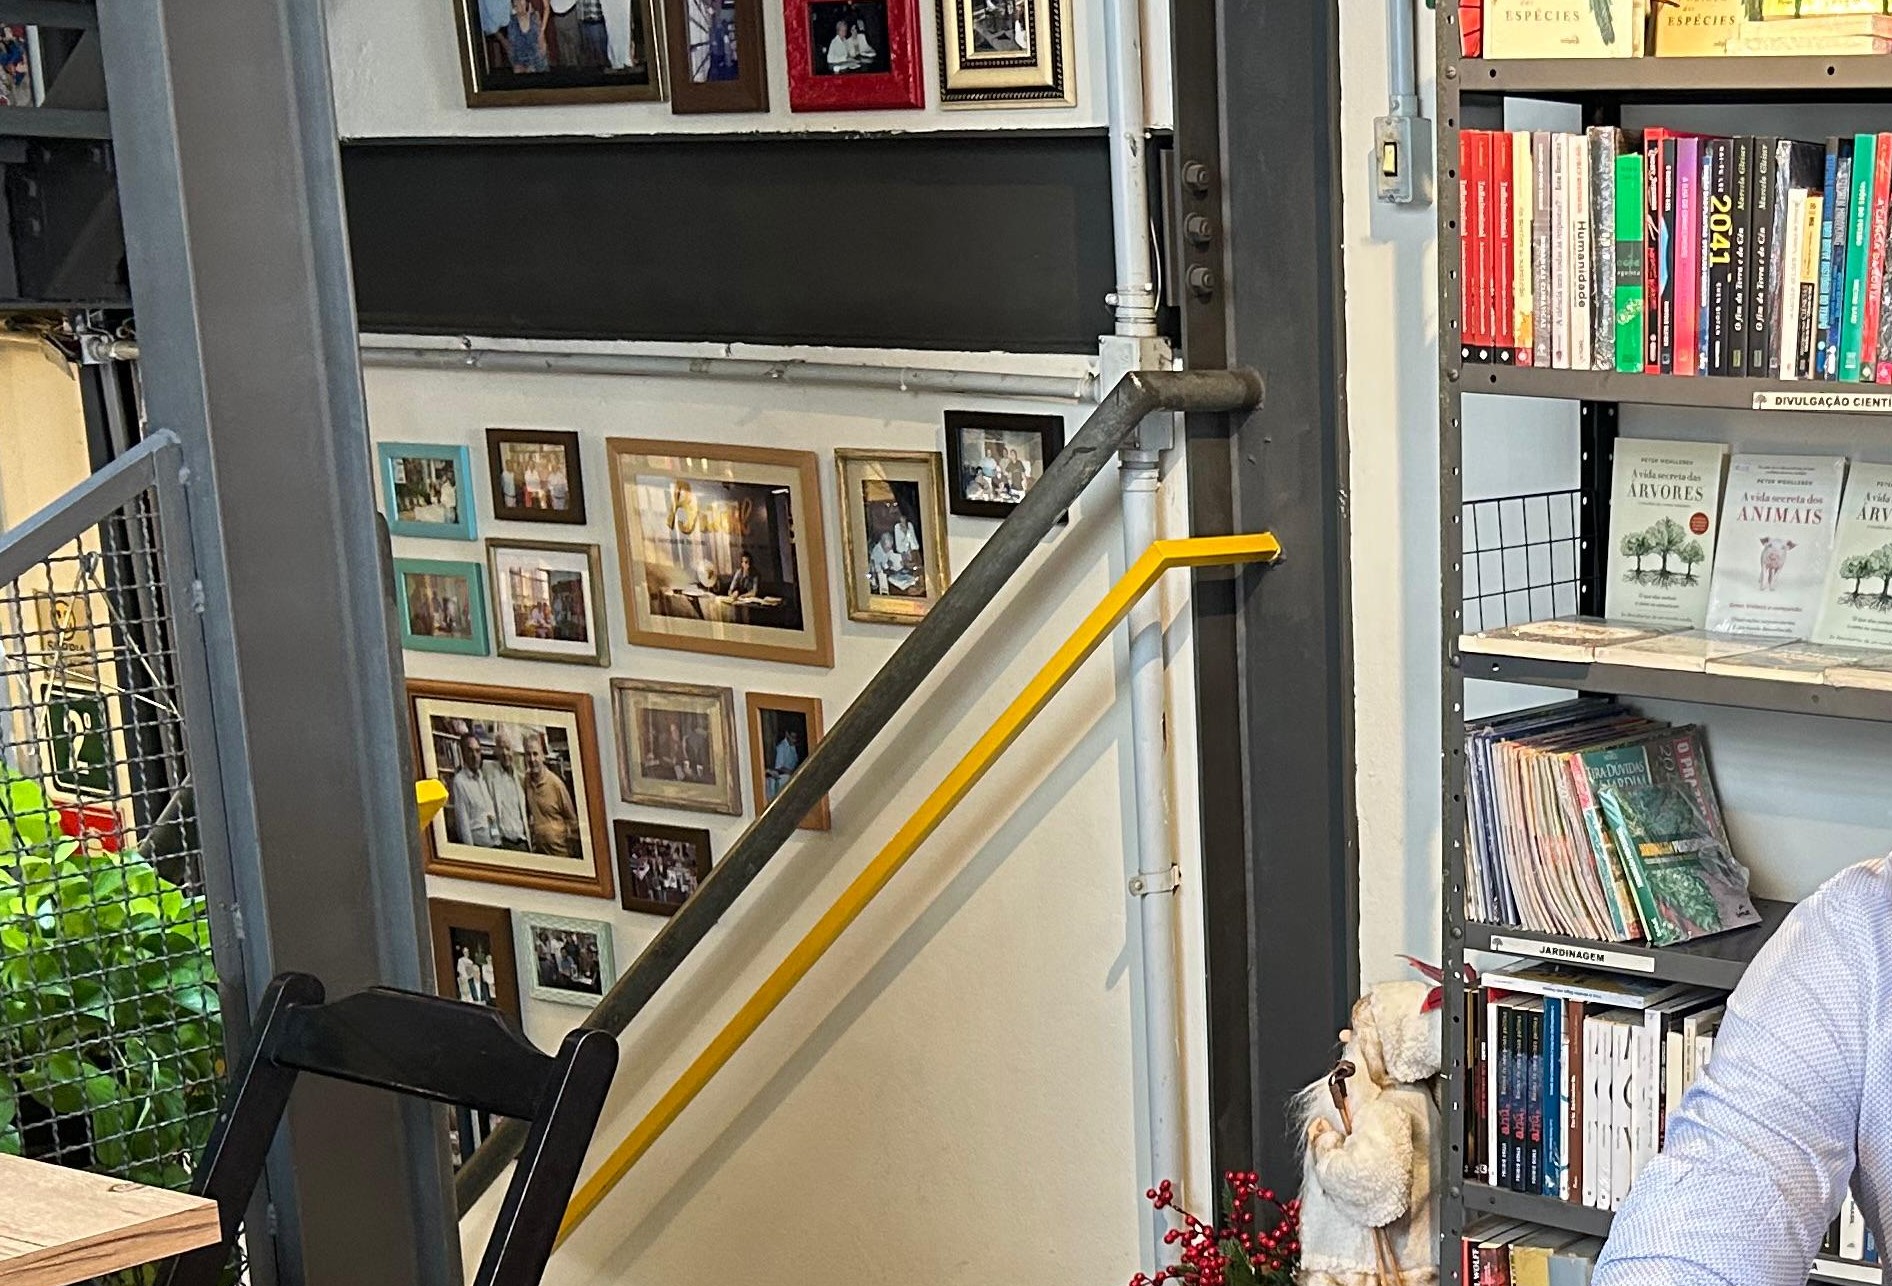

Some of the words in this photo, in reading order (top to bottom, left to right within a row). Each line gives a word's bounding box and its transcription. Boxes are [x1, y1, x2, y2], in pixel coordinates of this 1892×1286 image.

[1504, 9, 1582, 24] ESPÉCIES
[1666, 13, 1737, 28] ESPÉCIES
[1709, 194, 1731, 268] 2041
[1578, 221, 1586, 308] Humanidade
[1774, 395, 1850, 411] DIVULGAÇÃO
[1632, 469, 1638, 479] A
[1639, 469, 1657, 480] vida
[1658, 471, 1686, 481] secreta
[1688, 472, 1701, 482] das
[1627, 480, 1704, 501] ÁRVORES
[1742, 492, 1749, 501] A
[1751, 492, 1768, 502] vida
[1770, 493, 1806, 504] secreta
[1809, 495, 1823, 504] dos
[1865, 492, 1871, 501] A
[1873, 492, 1890, 503] vida
[1736, 506, 1822, 525] ANIMAIS
[1539, 945, 1605, 963] JARDINAGEM
[1473, 1248, 1482, 1278] WOLFF
